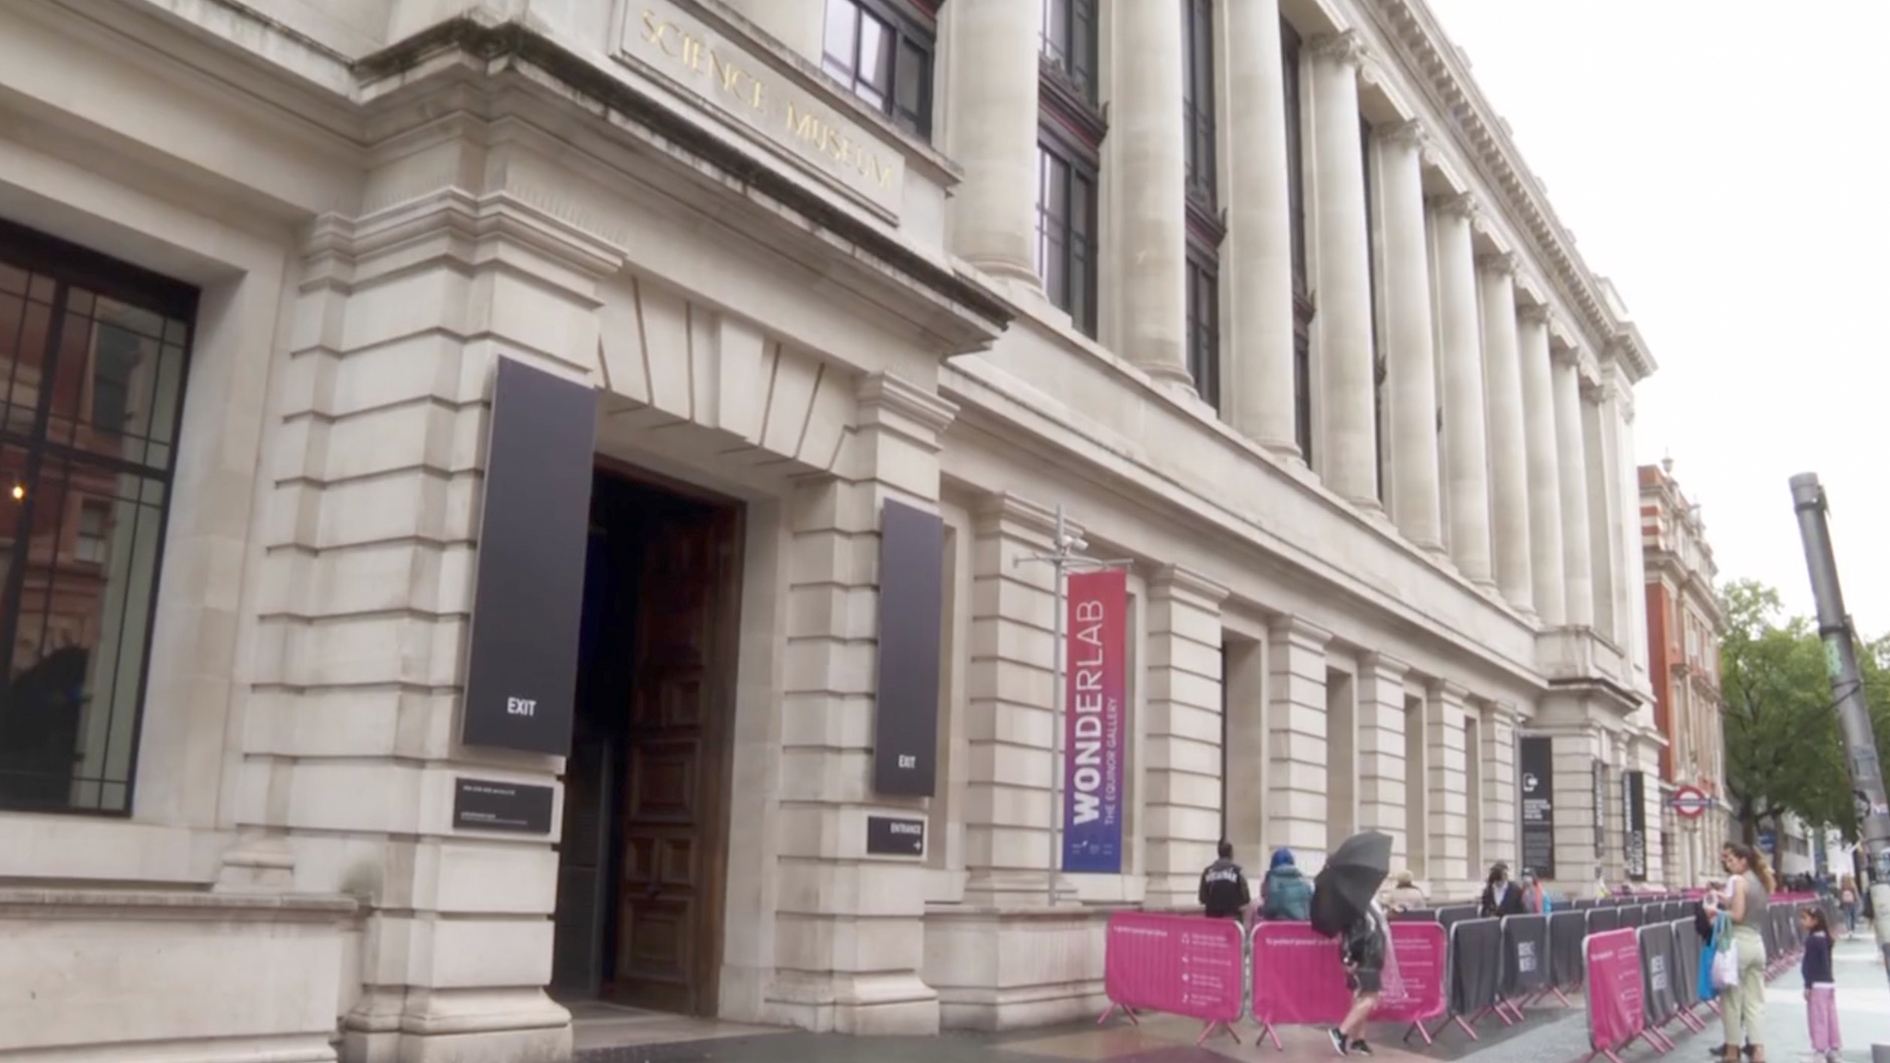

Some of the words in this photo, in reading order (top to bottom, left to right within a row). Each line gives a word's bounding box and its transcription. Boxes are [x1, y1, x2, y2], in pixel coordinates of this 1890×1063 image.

[640, 8, 767, 110] SCIENCE
[785, 100, 894, 190] MUSEUM
[506, 697, 537, 717] EXIT
[1073, 600, 1104, 826] WONDERLAB
[1105, 696, 1119, 749] GALLERY
[898, 754, 916, 769] EXIT
[1104, 749, 1117, 801] EQUINOR
[890, 822, 922, 835] ENTRANCE
[1104, 803, 1116, 826] THE
